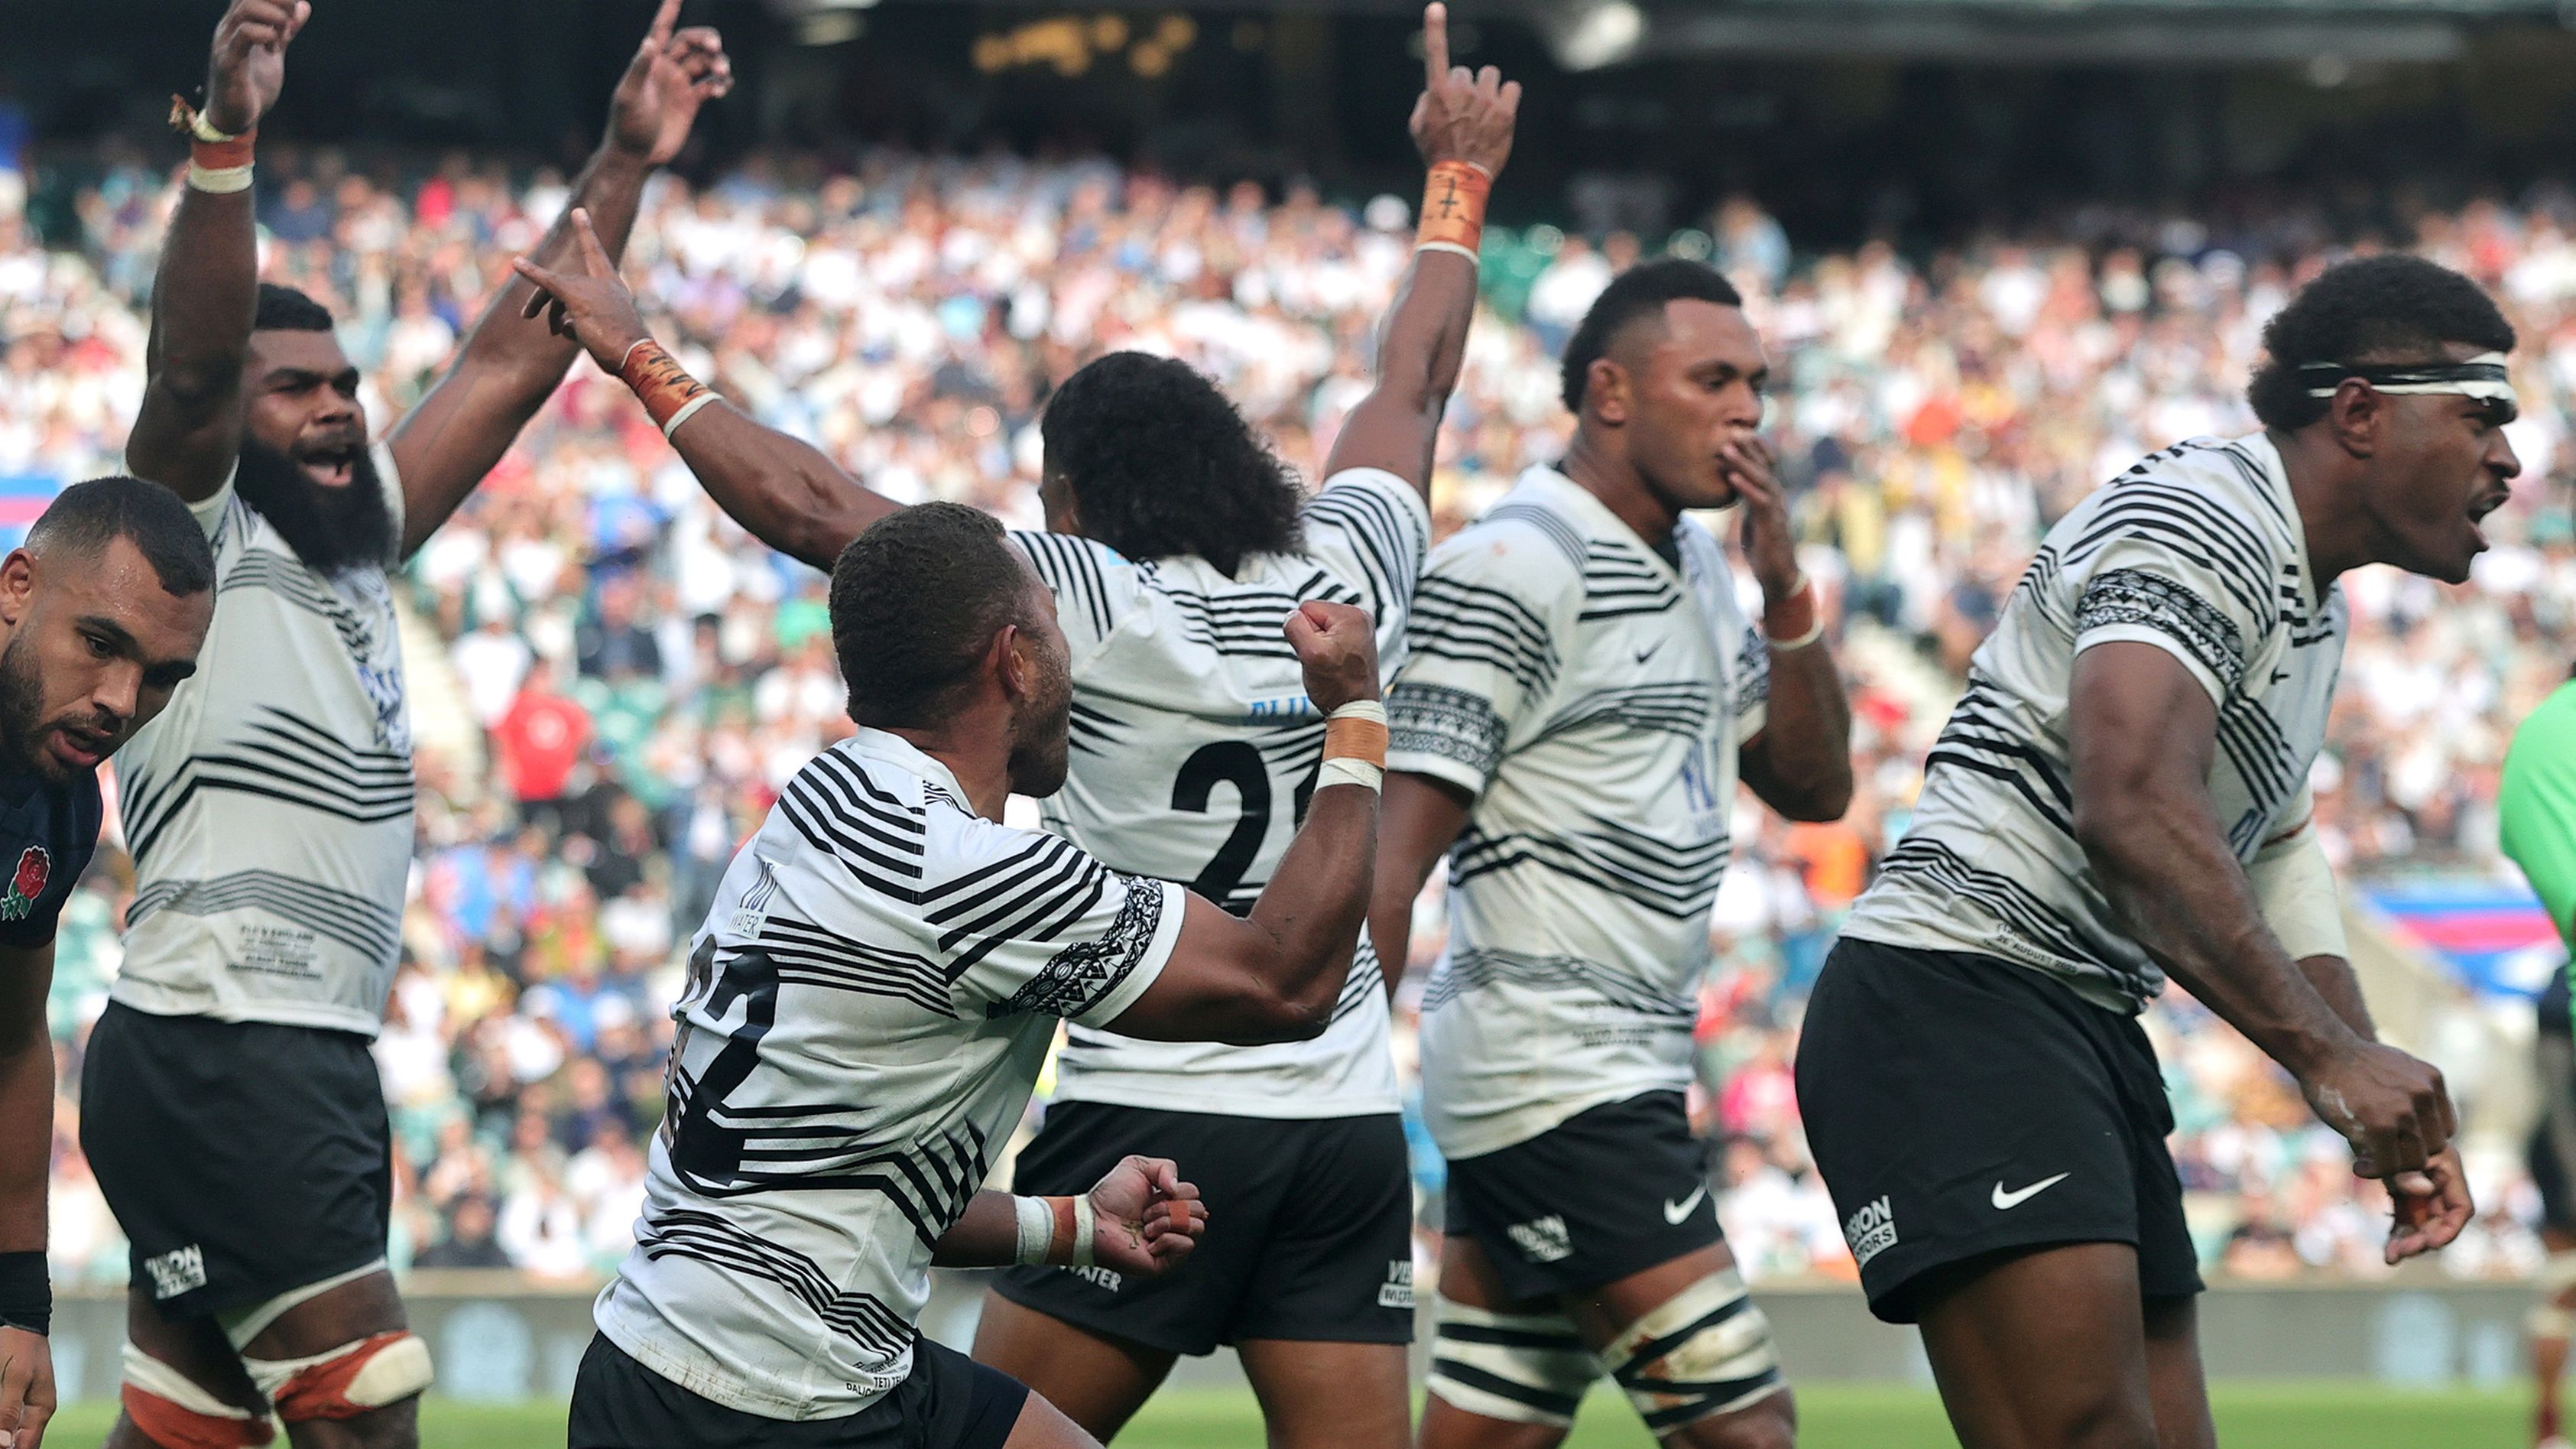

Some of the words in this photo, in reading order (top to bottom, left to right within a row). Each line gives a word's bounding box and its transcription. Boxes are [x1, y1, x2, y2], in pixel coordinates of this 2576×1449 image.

[1172, 740, 1325, 920] 2
[729, 914, 759, 934] WATER
[1059, 1265, 1121, 1293] ATER
[874, 1377, 891, 1389] TETI
